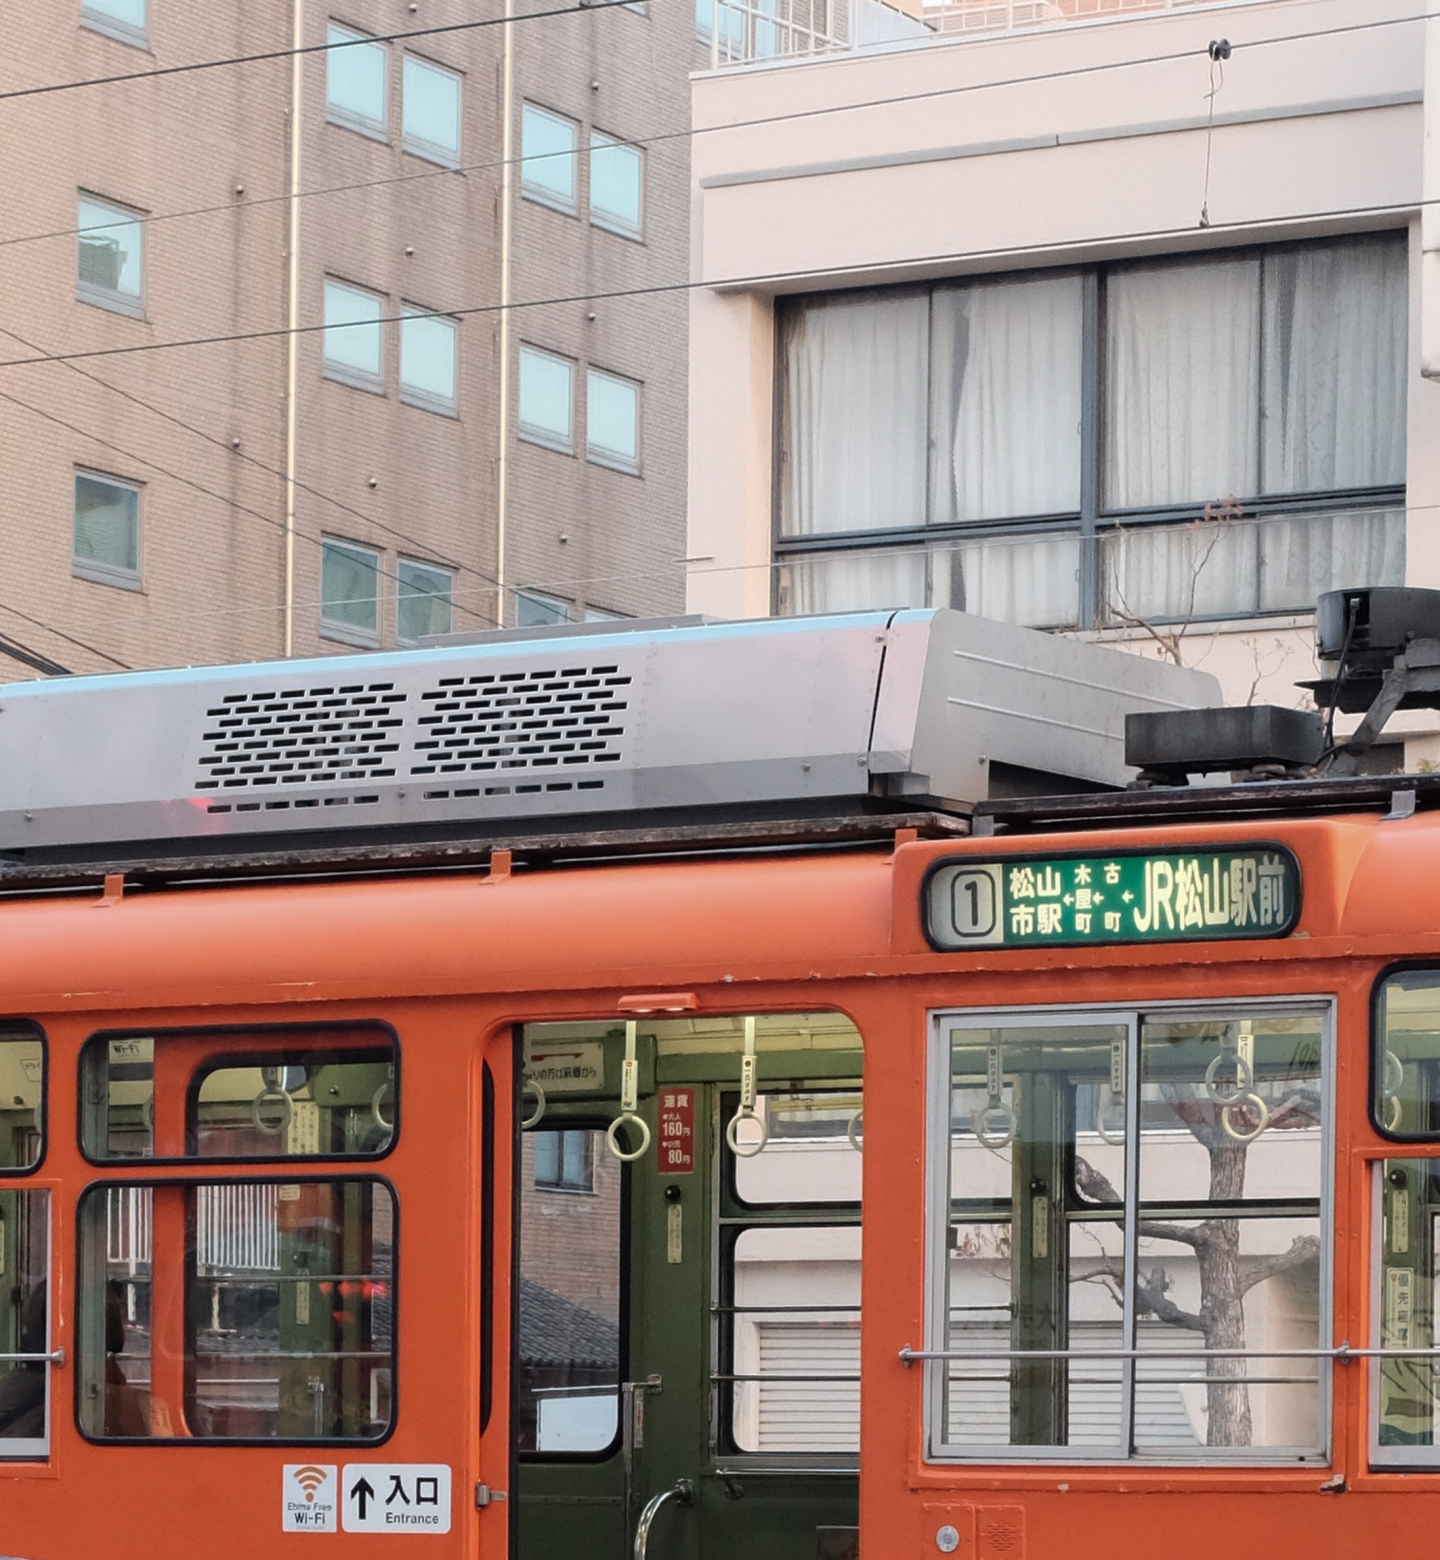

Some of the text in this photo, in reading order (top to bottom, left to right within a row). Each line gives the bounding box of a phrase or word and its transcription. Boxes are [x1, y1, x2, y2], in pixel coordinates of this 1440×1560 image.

[1009, 866, 1062, 900] 松山
[1133, 854, 1285, 933] JR松山駅前
[964, 880, 979, 927] 1
[1009, 903, 1063, 936] 市駅
[662, 1121, 691, 1136] 160円
[668, 1149, 691, 1164] 80円
[385, 1475, 438, 1506] 入口
[294, 1512, 326, 1525] Wi-Fi
[385, 1512, 439, 1525] Entrance
